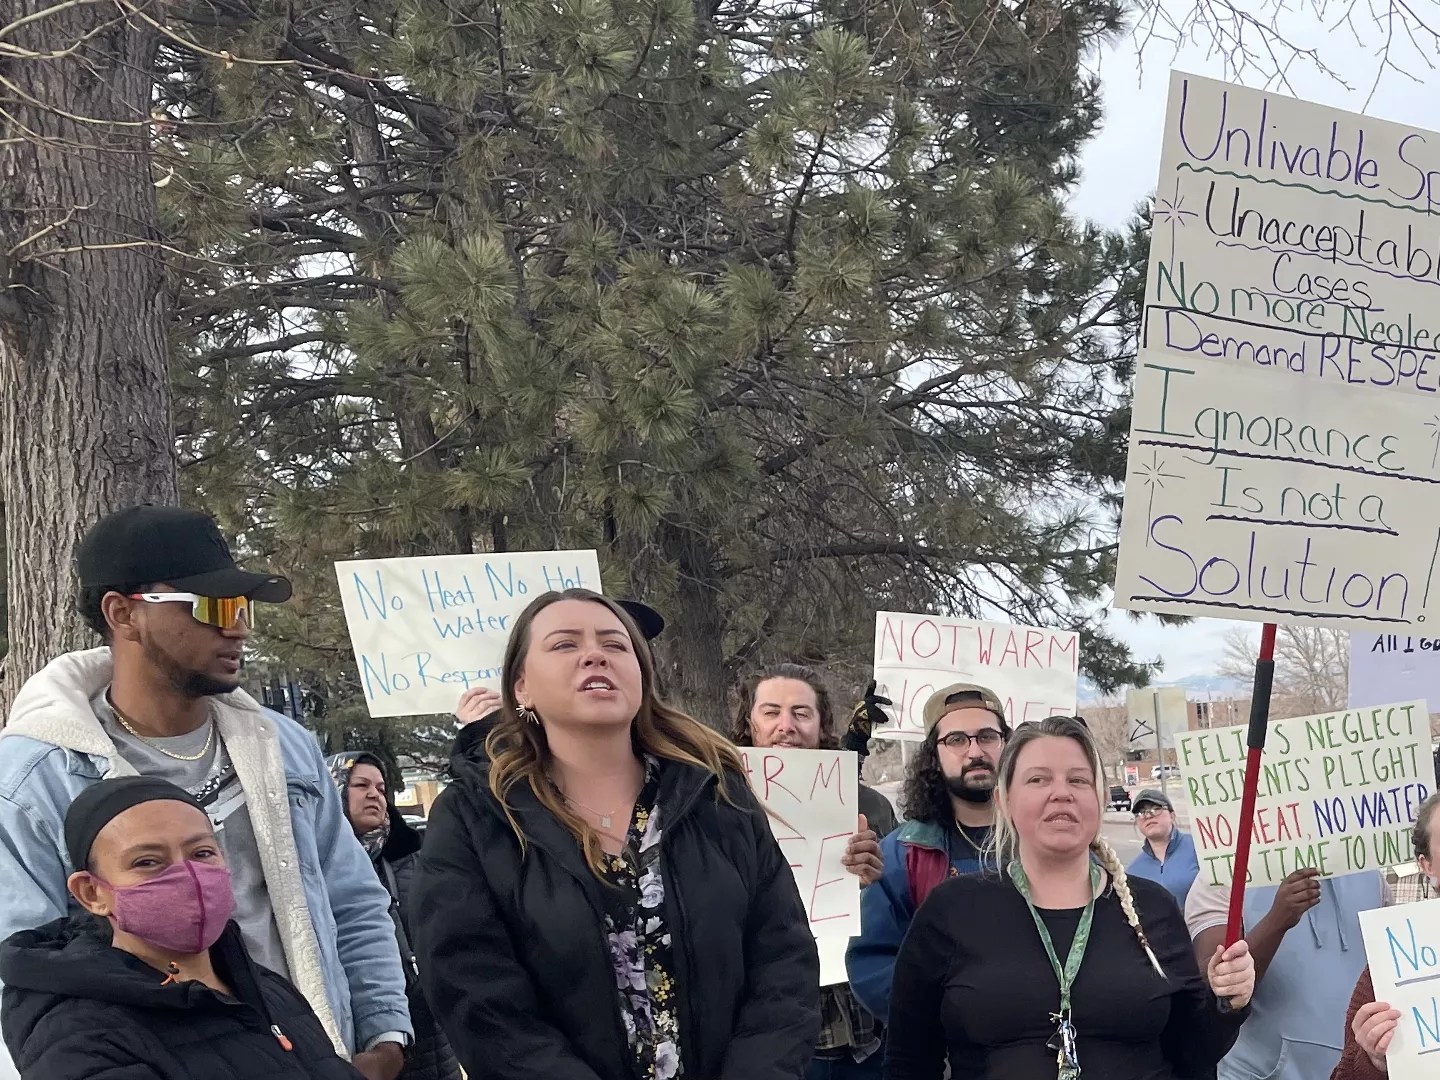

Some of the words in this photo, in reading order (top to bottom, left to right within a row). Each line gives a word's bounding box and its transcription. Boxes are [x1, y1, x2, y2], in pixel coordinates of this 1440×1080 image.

[1180, 80, 1380, 188] Unlivable
[1158, 262, 1219, 314] No
[1232, 287, 1326, 329] more
[1272, 253, 1371, 308] Cases
[1165, 310, 1306, 373] Demand
[1210, 466, 1264, 514] Is
[1280, 483, 1347, 521] not
[1359, 495, 1391, 529] a
[353, 569, 404, 620] No
[422, 568, 477, 612] Heat
[485, 561, 528, 601] No
[1138, 515, 1440, 622] Solution!
[880, 617, 973, 665] NOT
[977, 626, 1077, 673] WARM
[1371, 634, 1397, 653] All
[362, 652, 410, 700] No
[1305, 705, 1415, 751] NEGLECT
[1322, 743, 1418, 789] PLIGHT
[1195, 813, 1233, 850] NO
[1313, 793, 1347, 838] NO
[1258, 841, 1334, 882] TIME
[1339, 834, 1367, 870] TO
[1385, 918, 1437, 979] No
